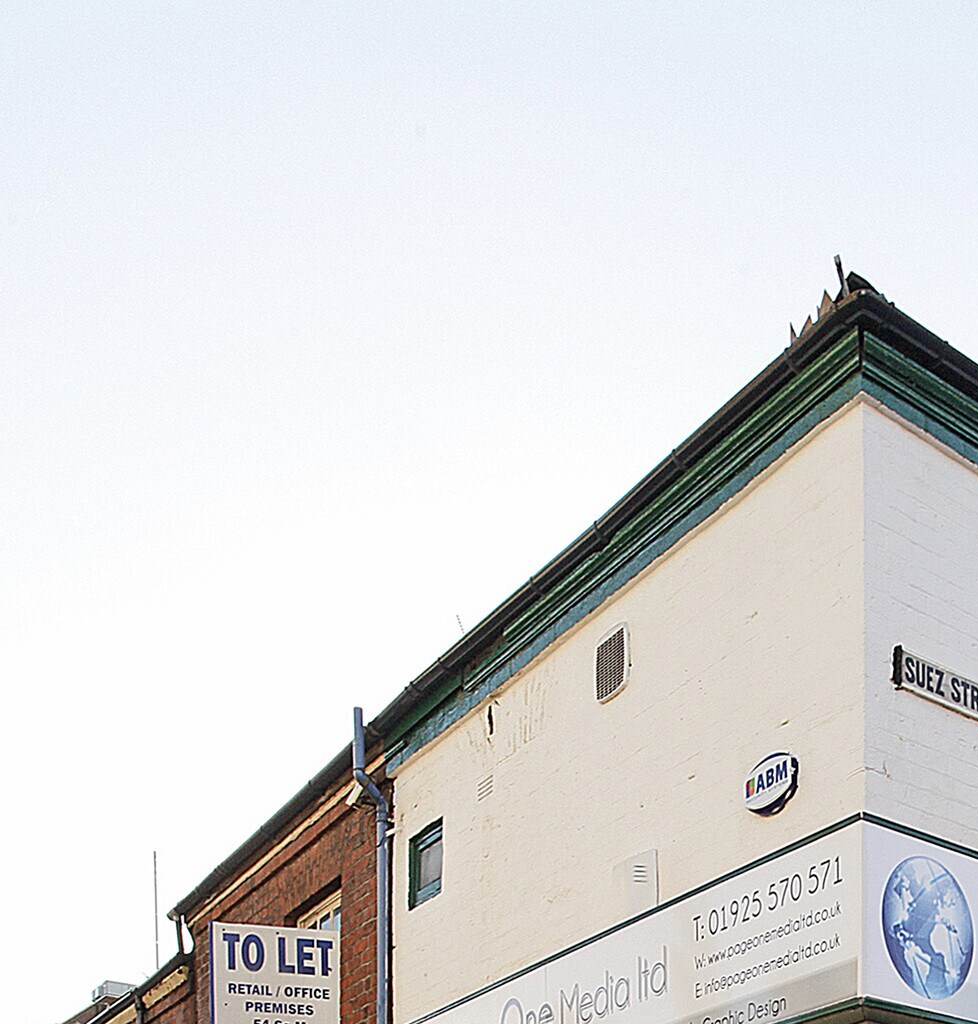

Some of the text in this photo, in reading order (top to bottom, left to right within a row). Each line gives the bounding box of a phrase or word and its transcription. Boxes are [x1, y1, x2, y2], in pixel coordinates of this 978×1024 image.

[904, 656, 946, 698] SUEZ
[756, 759, 788, 794] ABM
[693, 856, 843, 942] T: 01925 570 571
[222, 932, 333, 977] TO LET
[708, 901, 843, 966] www.pageonemedialtd.co.uk
[637, 945, 668, 1002] ltd
[704, 933, 842, 996] info@pageonemedialtd.co.uk
[228, 983, 273, 996] RETAIL
[284, 986, 330, 1000] OFFICE
[245, 1002, 315, 1016] PREMISES
[747, 997, 787, 1022] Design
